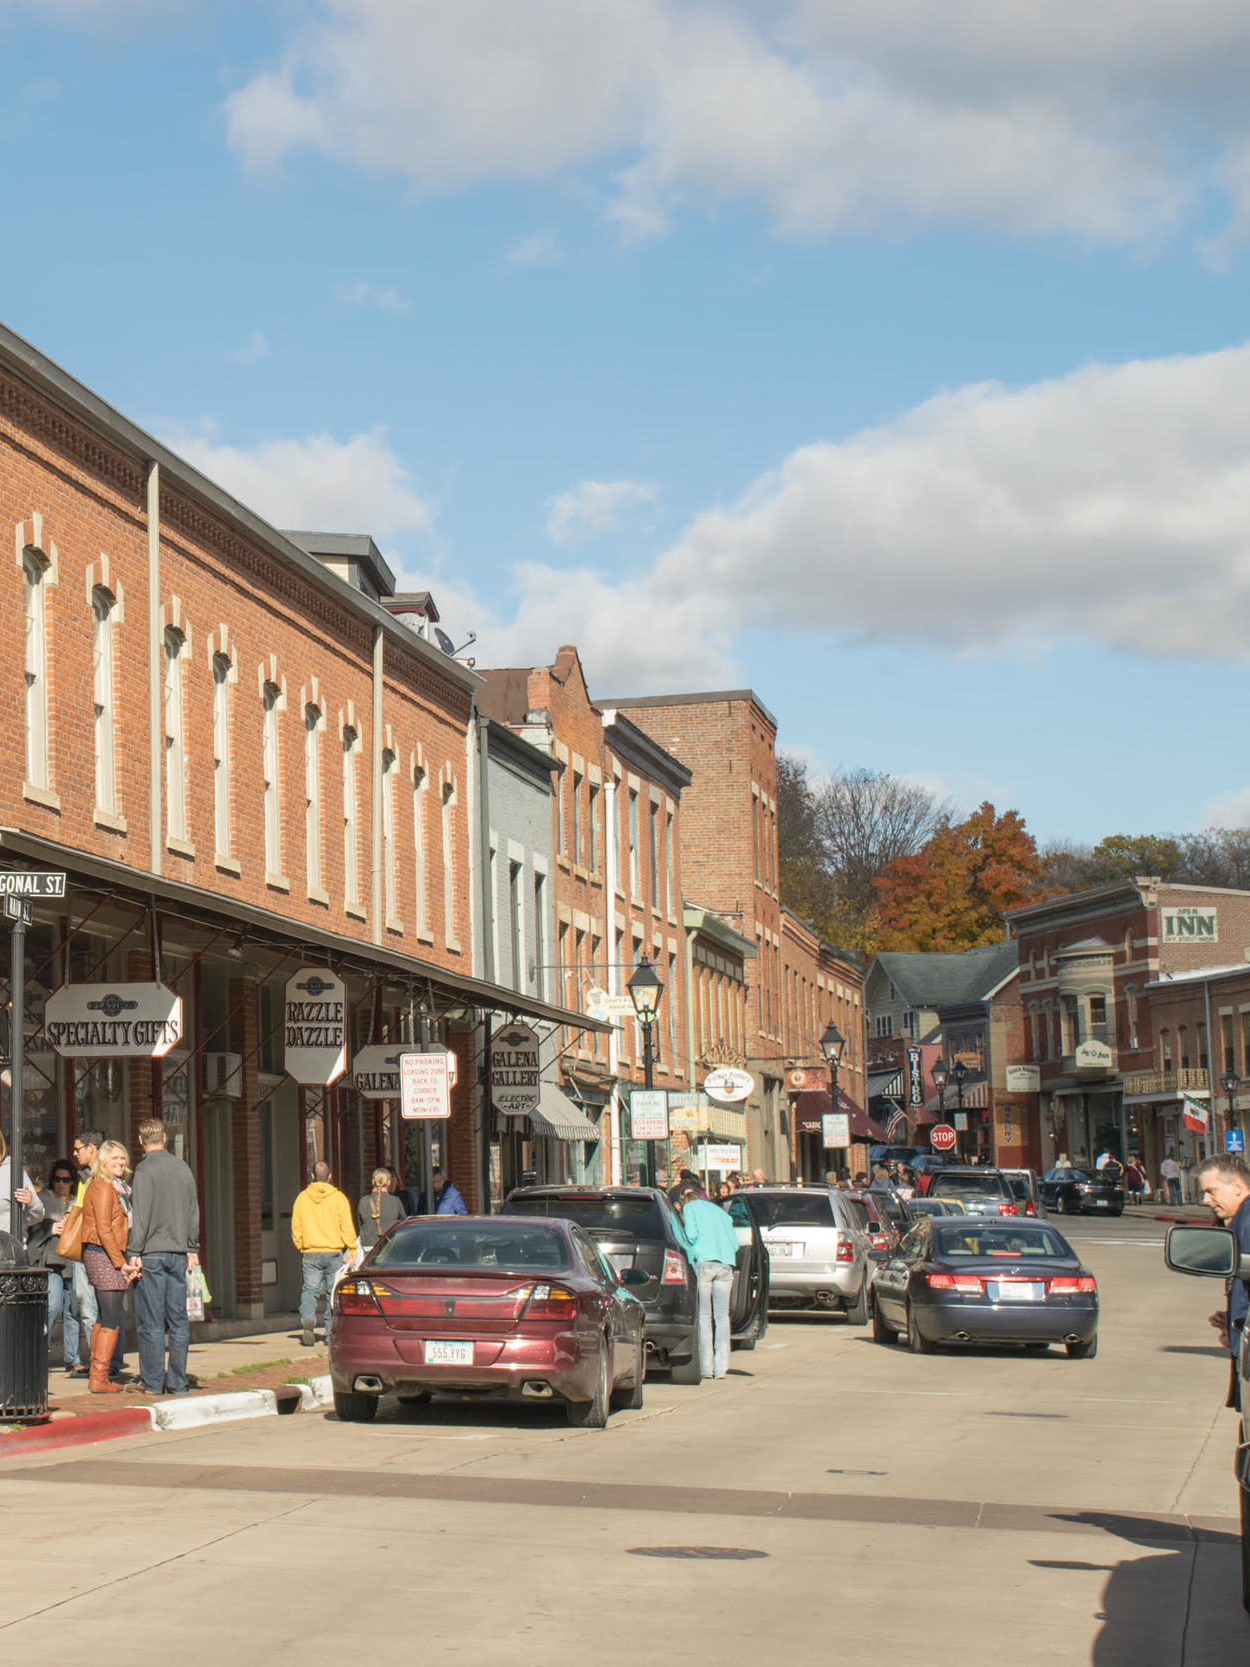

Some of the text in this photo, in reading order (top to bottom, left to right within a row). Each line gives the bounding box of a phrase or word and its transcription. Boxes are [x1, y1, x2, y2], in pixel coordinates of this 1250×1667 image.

[1164, 916, 1215, 937] INN
[286, 1001, 343, 1022] RAZZLE
[47, 1020, 179, 1046] SPECIALTY GIFTS
[286, 1026, 343, 1047] DAZZLE
[415, 1057, 444, 1065] PARKING
[492, 1051, 539, 1067] GALENA
[492, 1071, 540, 1087] GALLERY
[910, 1052, 922, 1103] BISTRO
[932, 1132, 954, 1142] STOP
